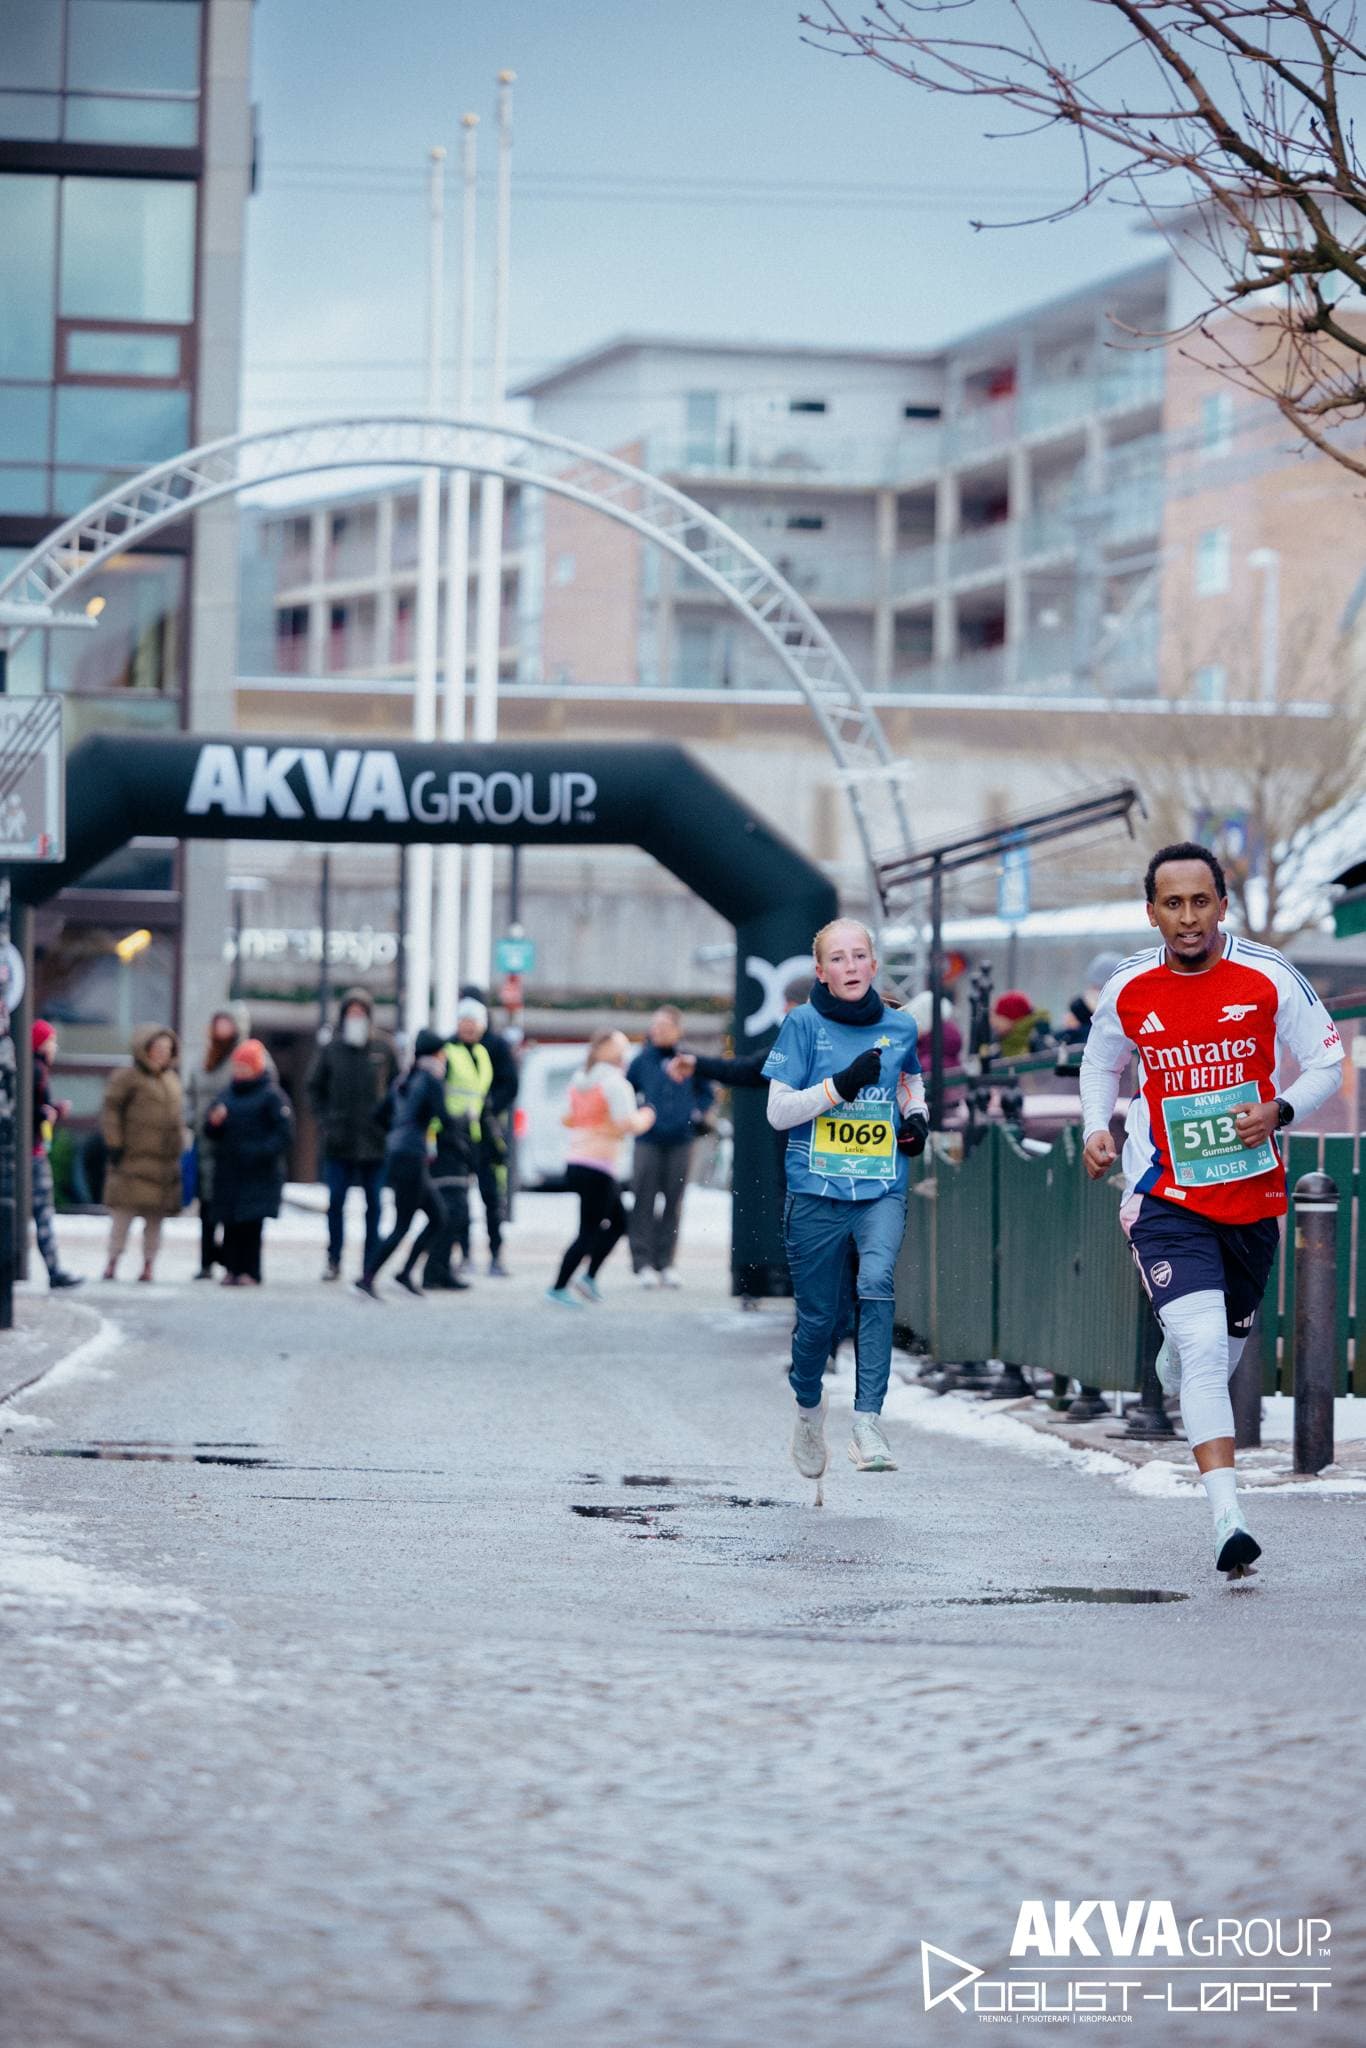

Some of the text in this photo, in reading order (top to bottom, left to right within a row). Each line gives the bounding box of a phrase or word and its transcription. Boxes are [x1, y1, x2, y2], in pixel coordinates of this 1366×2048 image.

[184, 744, 598, 826] AKVA GROUP
[768, 1050, 786, 1062] RØY
[1142, 1037, 1257, 1071] Emirates
[1164, 1062, 1244, 1093] FLY BETTER
[842, 1102, 865, 1111] AKVA
[1194, 1094, 1221, 1107] AKVA
[826, 1121, 887, 1146] 1069
[1182, 1112, 1248, 1149] 513
[1201, 1143, 1243, 1158] Gurmessa
[1206, 1160, 1248, 1179] AIDER
